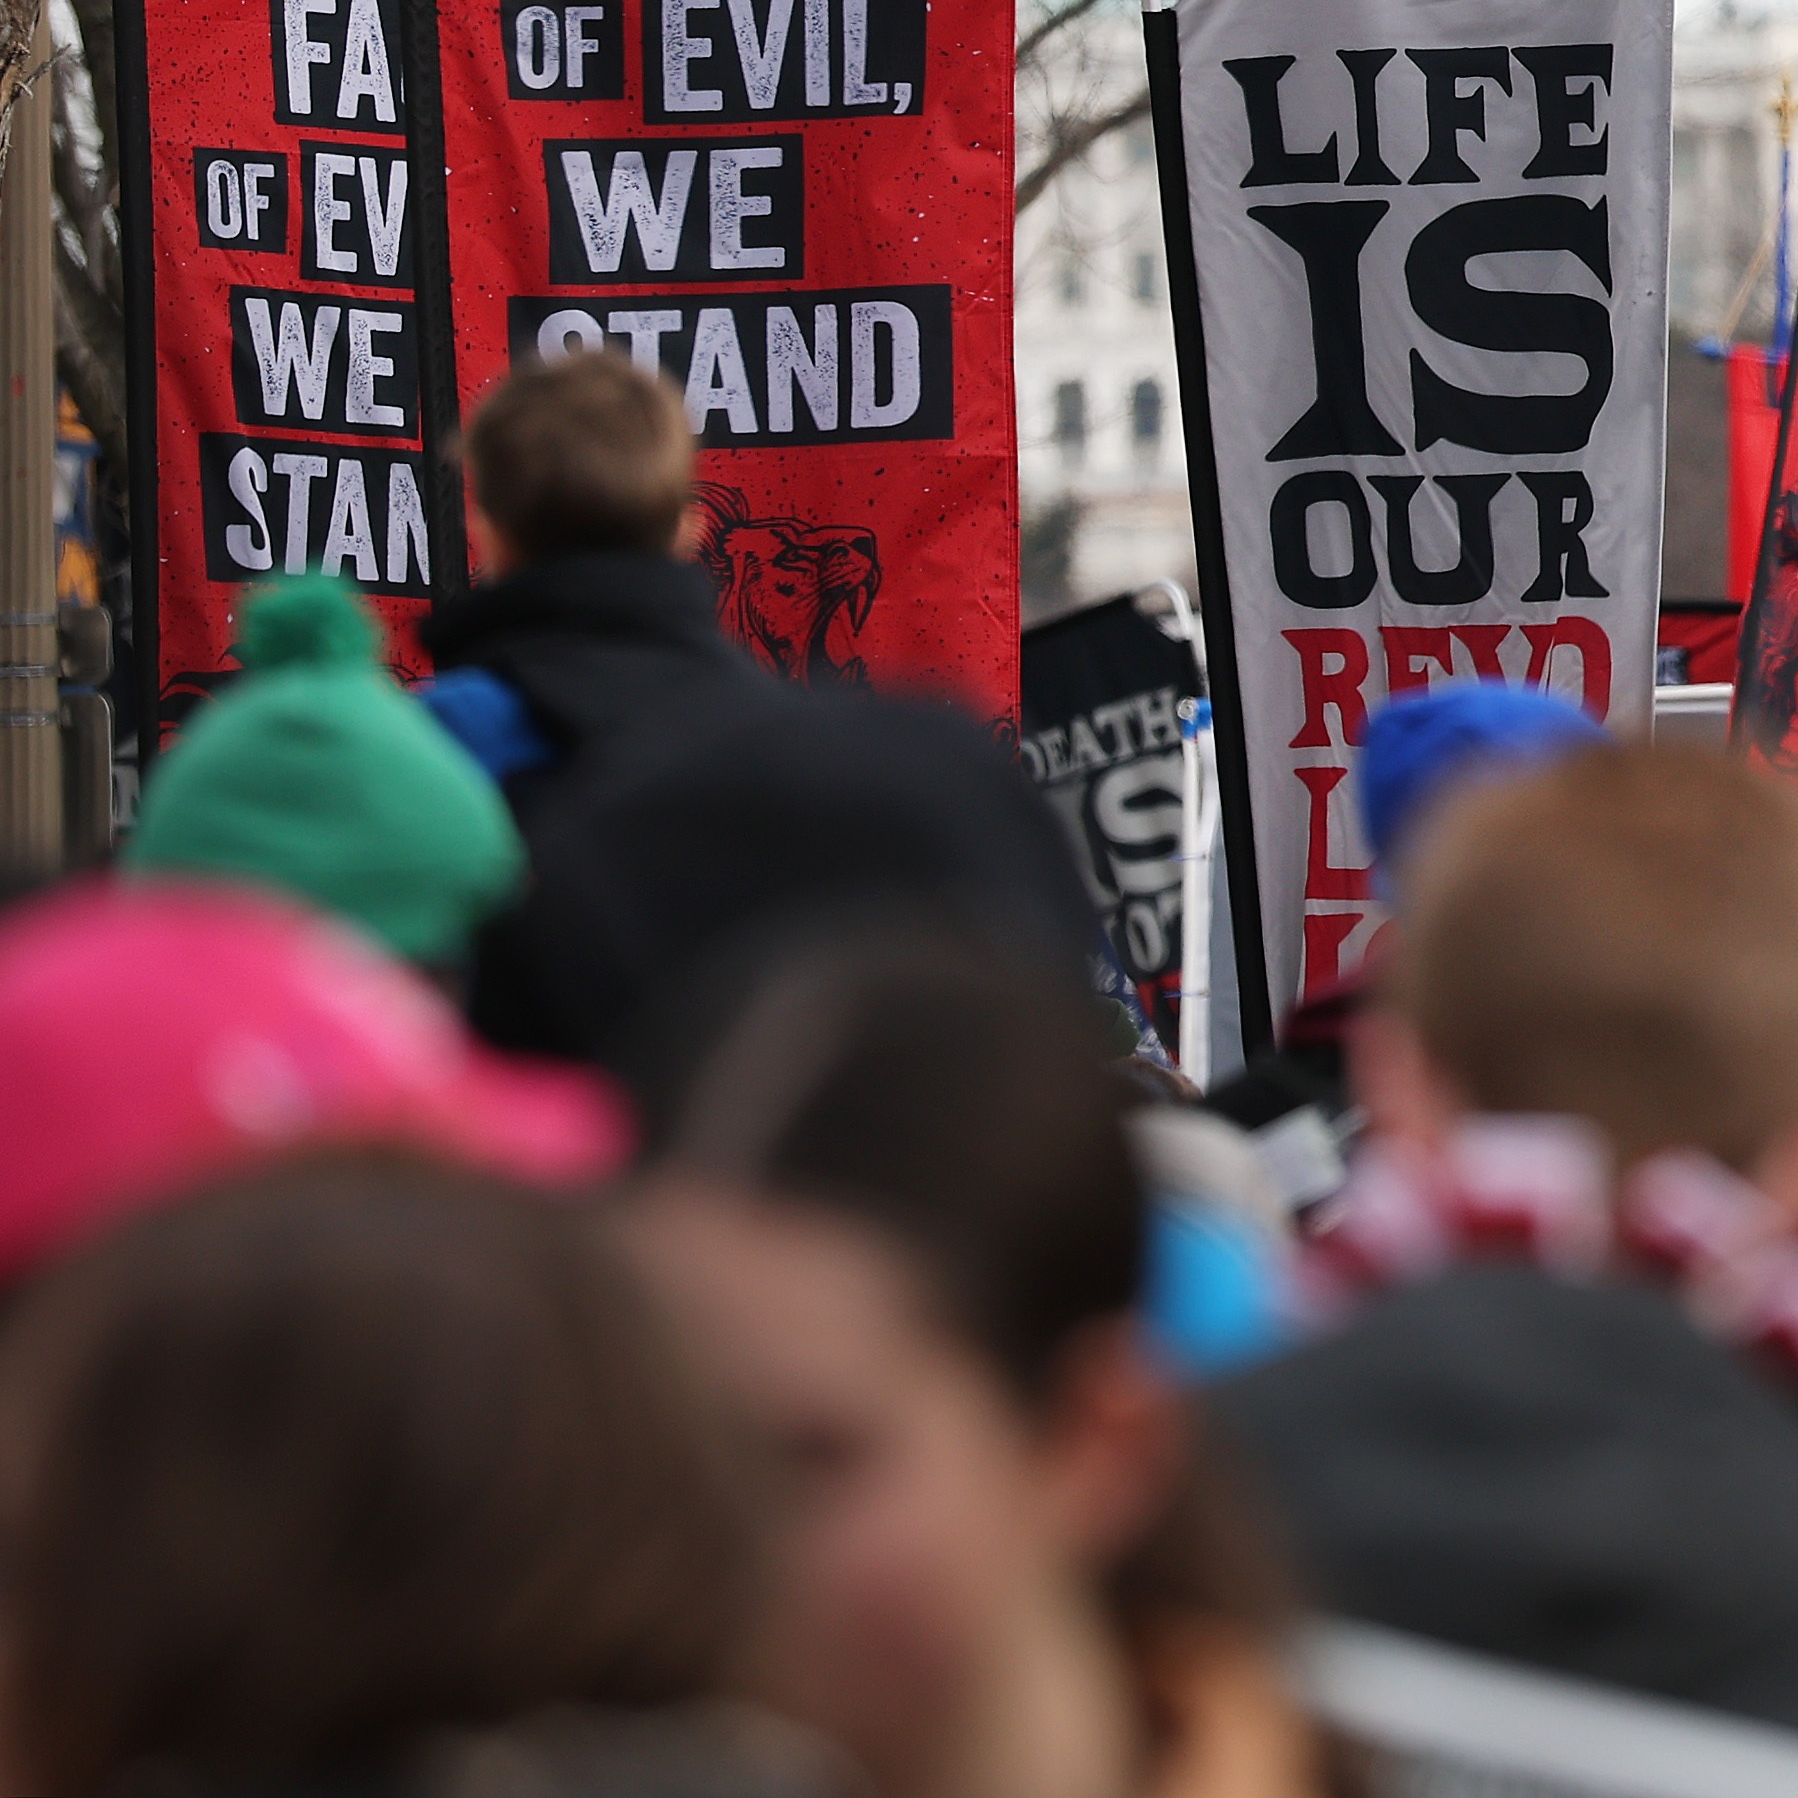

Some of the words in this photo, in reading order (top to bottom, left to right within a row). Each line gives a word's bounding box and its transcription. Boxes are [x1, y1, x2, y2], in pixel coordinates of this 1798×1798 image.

[515, 5, 604, 90] OF
[1221, 43, 1613, 188] LIFE
[206, 159, 275, 241] OF
[560, 146, 786, 274] WE
[245, 297, 405, 428] WE
[1246, 194, 1614, 463] IS
[226, 446, 431, 586] STAN
[1269, 470, 1611, 609] OUR
